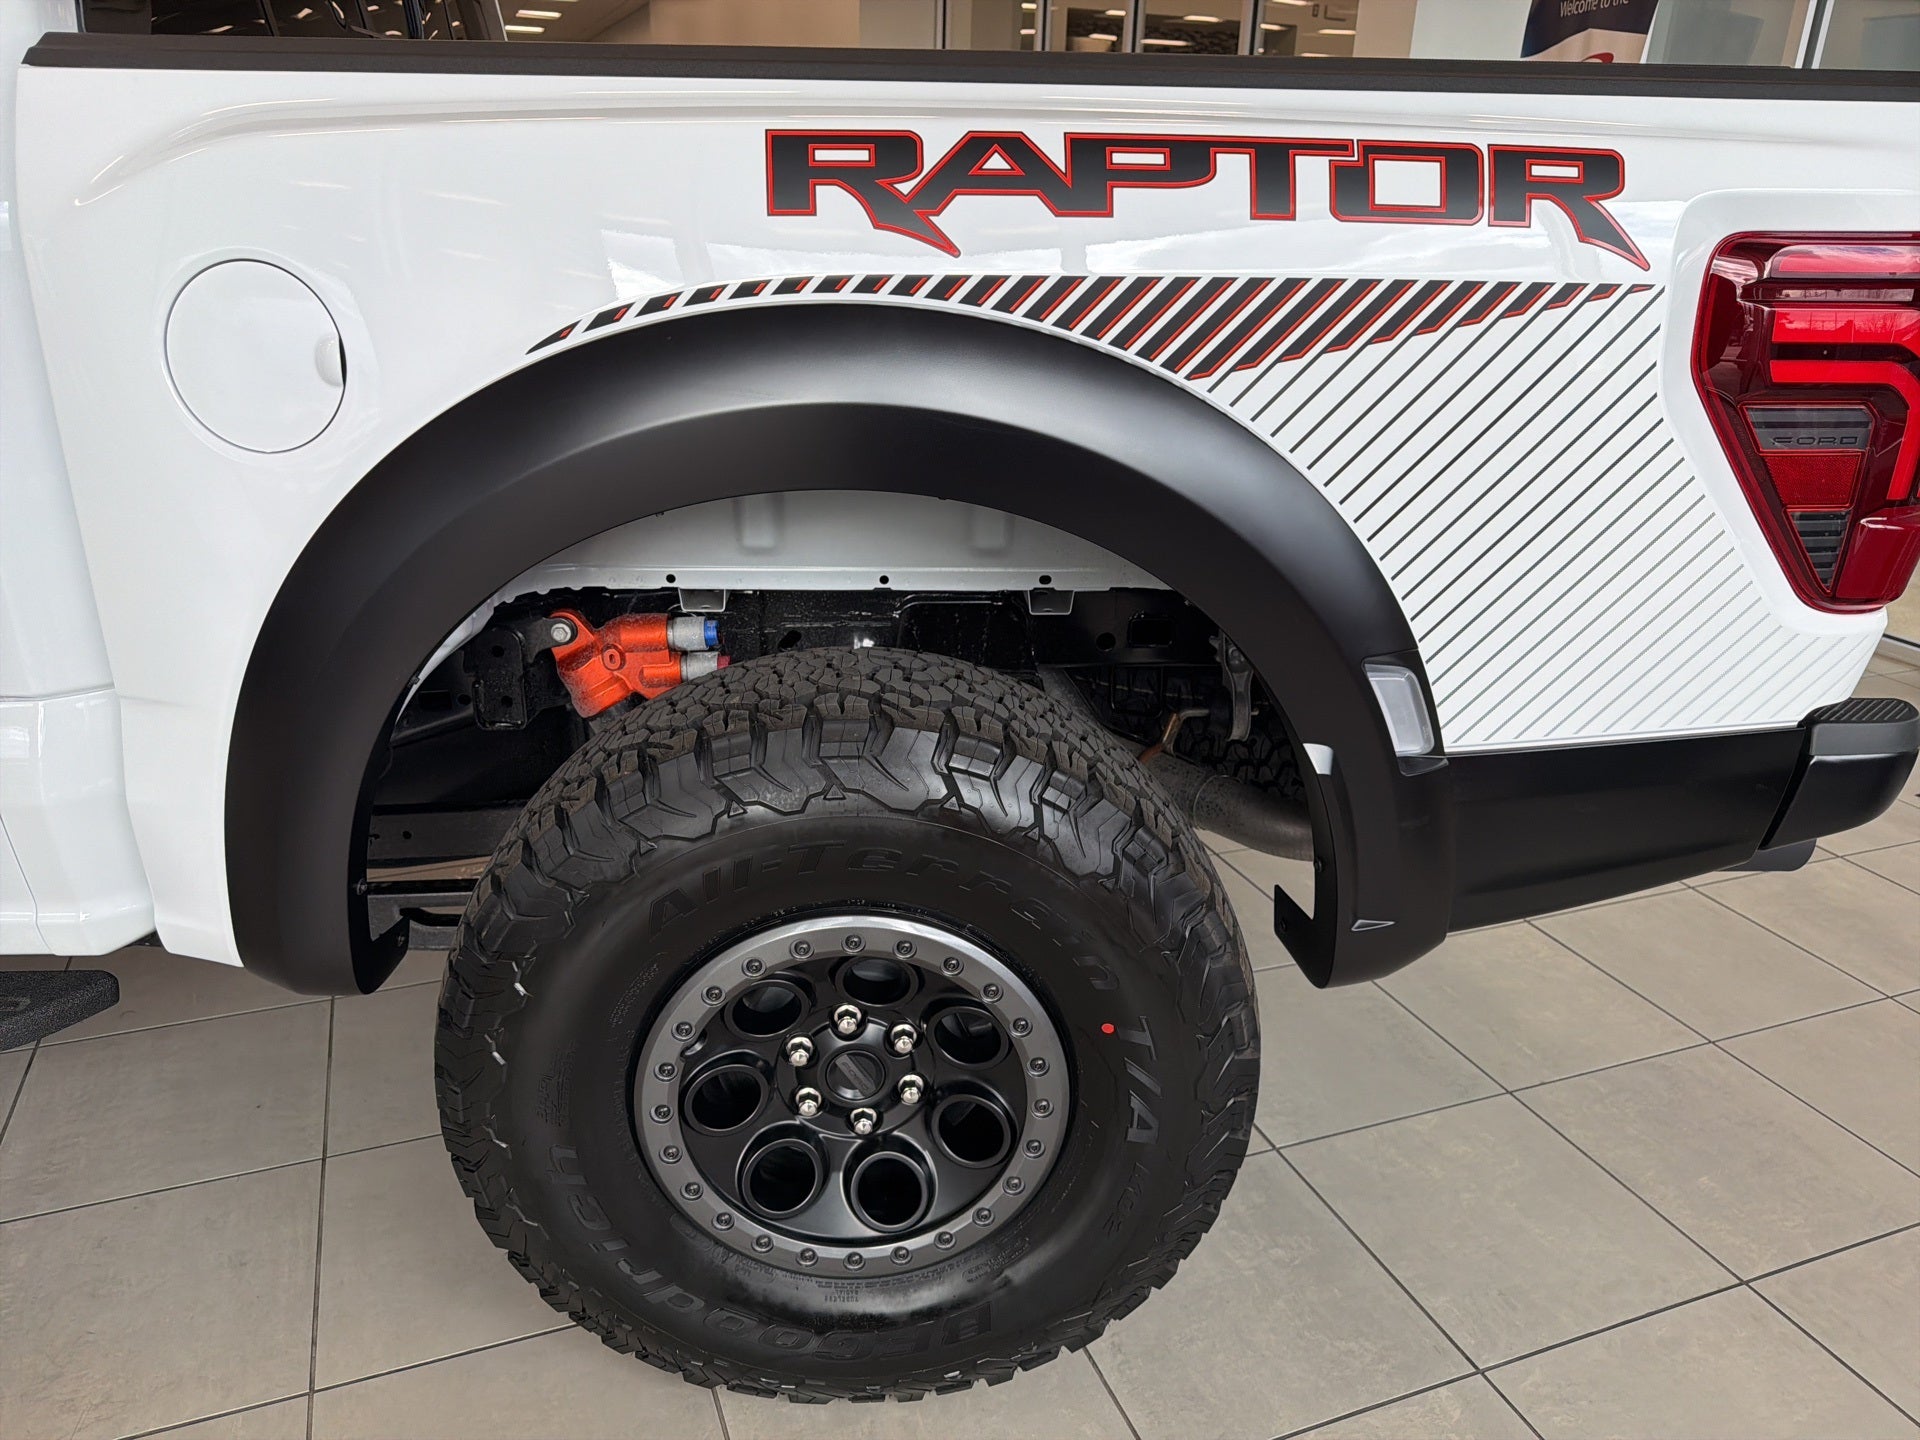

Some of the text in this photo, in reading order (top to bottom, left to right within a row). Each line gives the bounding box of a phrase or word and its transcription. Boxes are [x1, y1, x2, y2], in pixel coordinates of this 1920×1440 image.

[1560, 0, 1598, 18] Welcome
[765, 129, 1652, 271] RAPTOR
[1773, 436, 1858, 446] FORD
[648, 839, 1120, 990] All-Terrain
[1116, 1014, 1165, 1146] T/A
[546, 1145, 993, 1363] BFGoodrich
